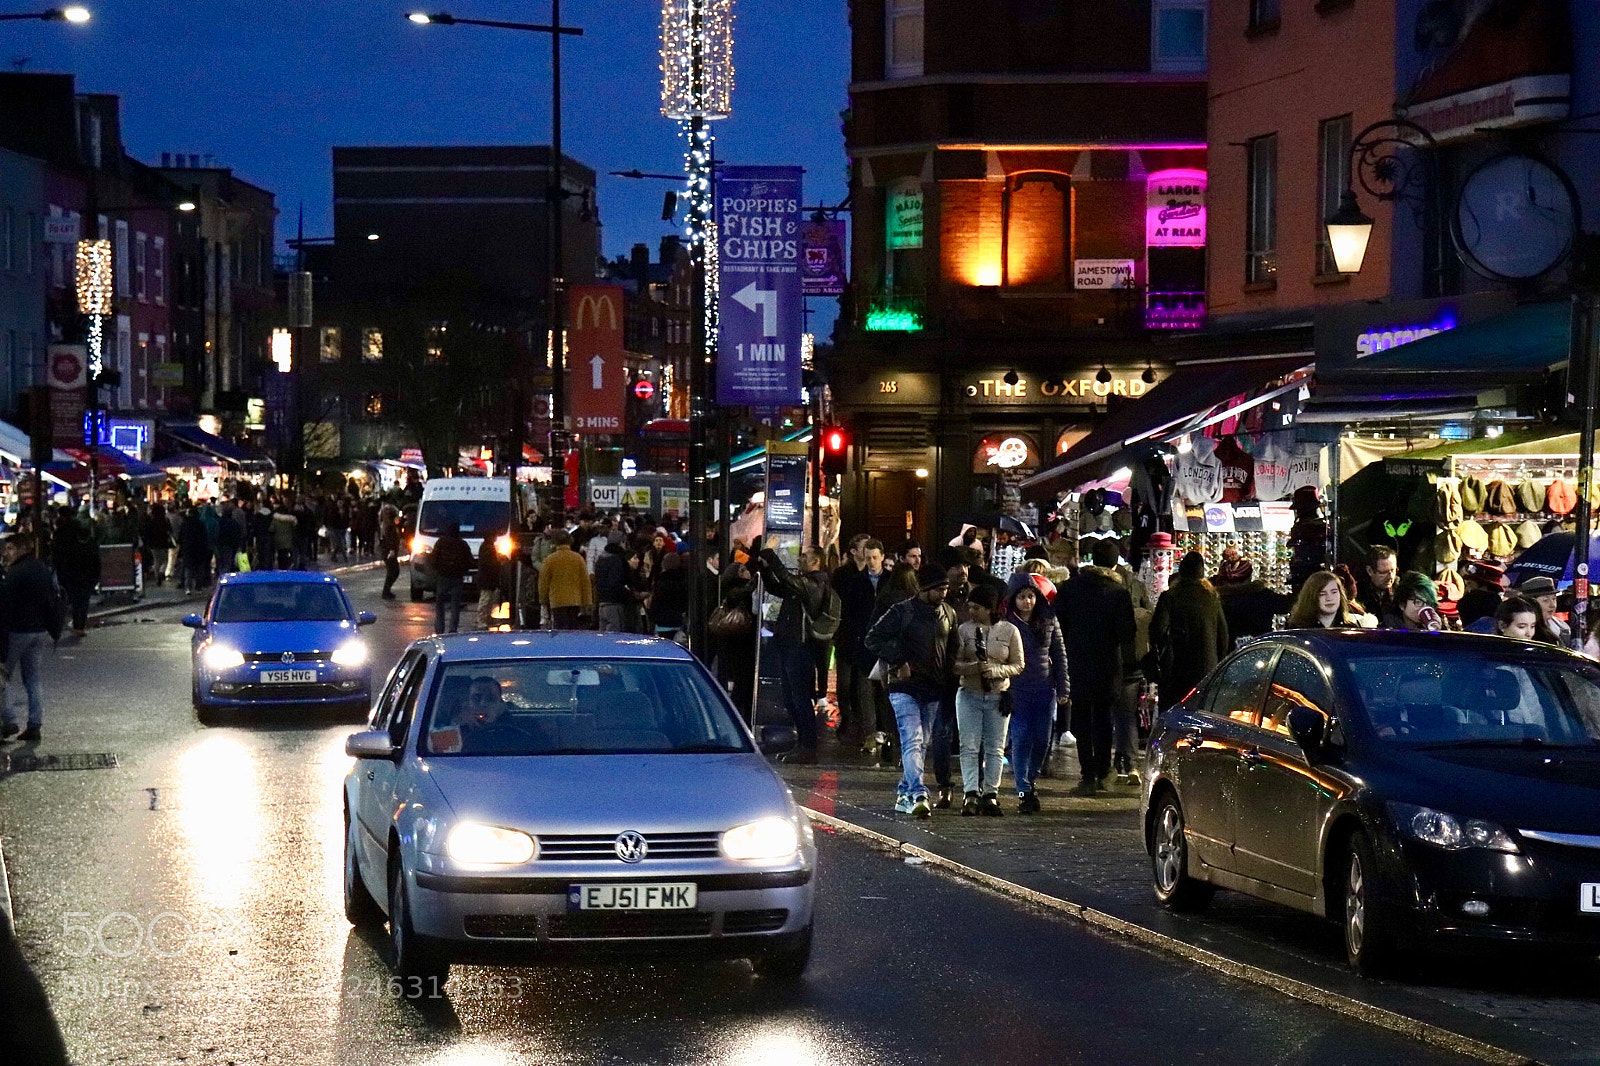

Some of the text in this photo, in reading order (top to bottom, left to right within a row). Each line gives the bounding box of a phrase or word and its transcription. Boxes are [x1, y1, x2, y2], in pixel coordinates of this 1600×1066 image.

[1158, 185, 1200, 196] LARGE
[722, 197, 797, 213] POPPIE'S
[723, 214, 798, 237] FISH &
[1155, 228, 1201, 237] AT REAR
[723, 237, 797, 259] CHIPS
[1077, 266, 1131, 275] JAMESTOWN
[1077, 277, 1103, 286] ROAD
[735, 343, 785, 361] 1 MIN
[879, 381, 898, 393] 265
[979, 379, 1147, 397] THE OXFORD
[576, 417, 619, 428] 3 MINS
[1183, 466, 1215, 482] LONDON
[1254, 463, 1287, 478] LONDON
[593, 488, 616, 500] OUT
[1522, 562, 1563, 572] DUNLOP
[268, 672, 311, 681] YS15 HVG
[587, 887, 689, 908] EJ51 FMK
